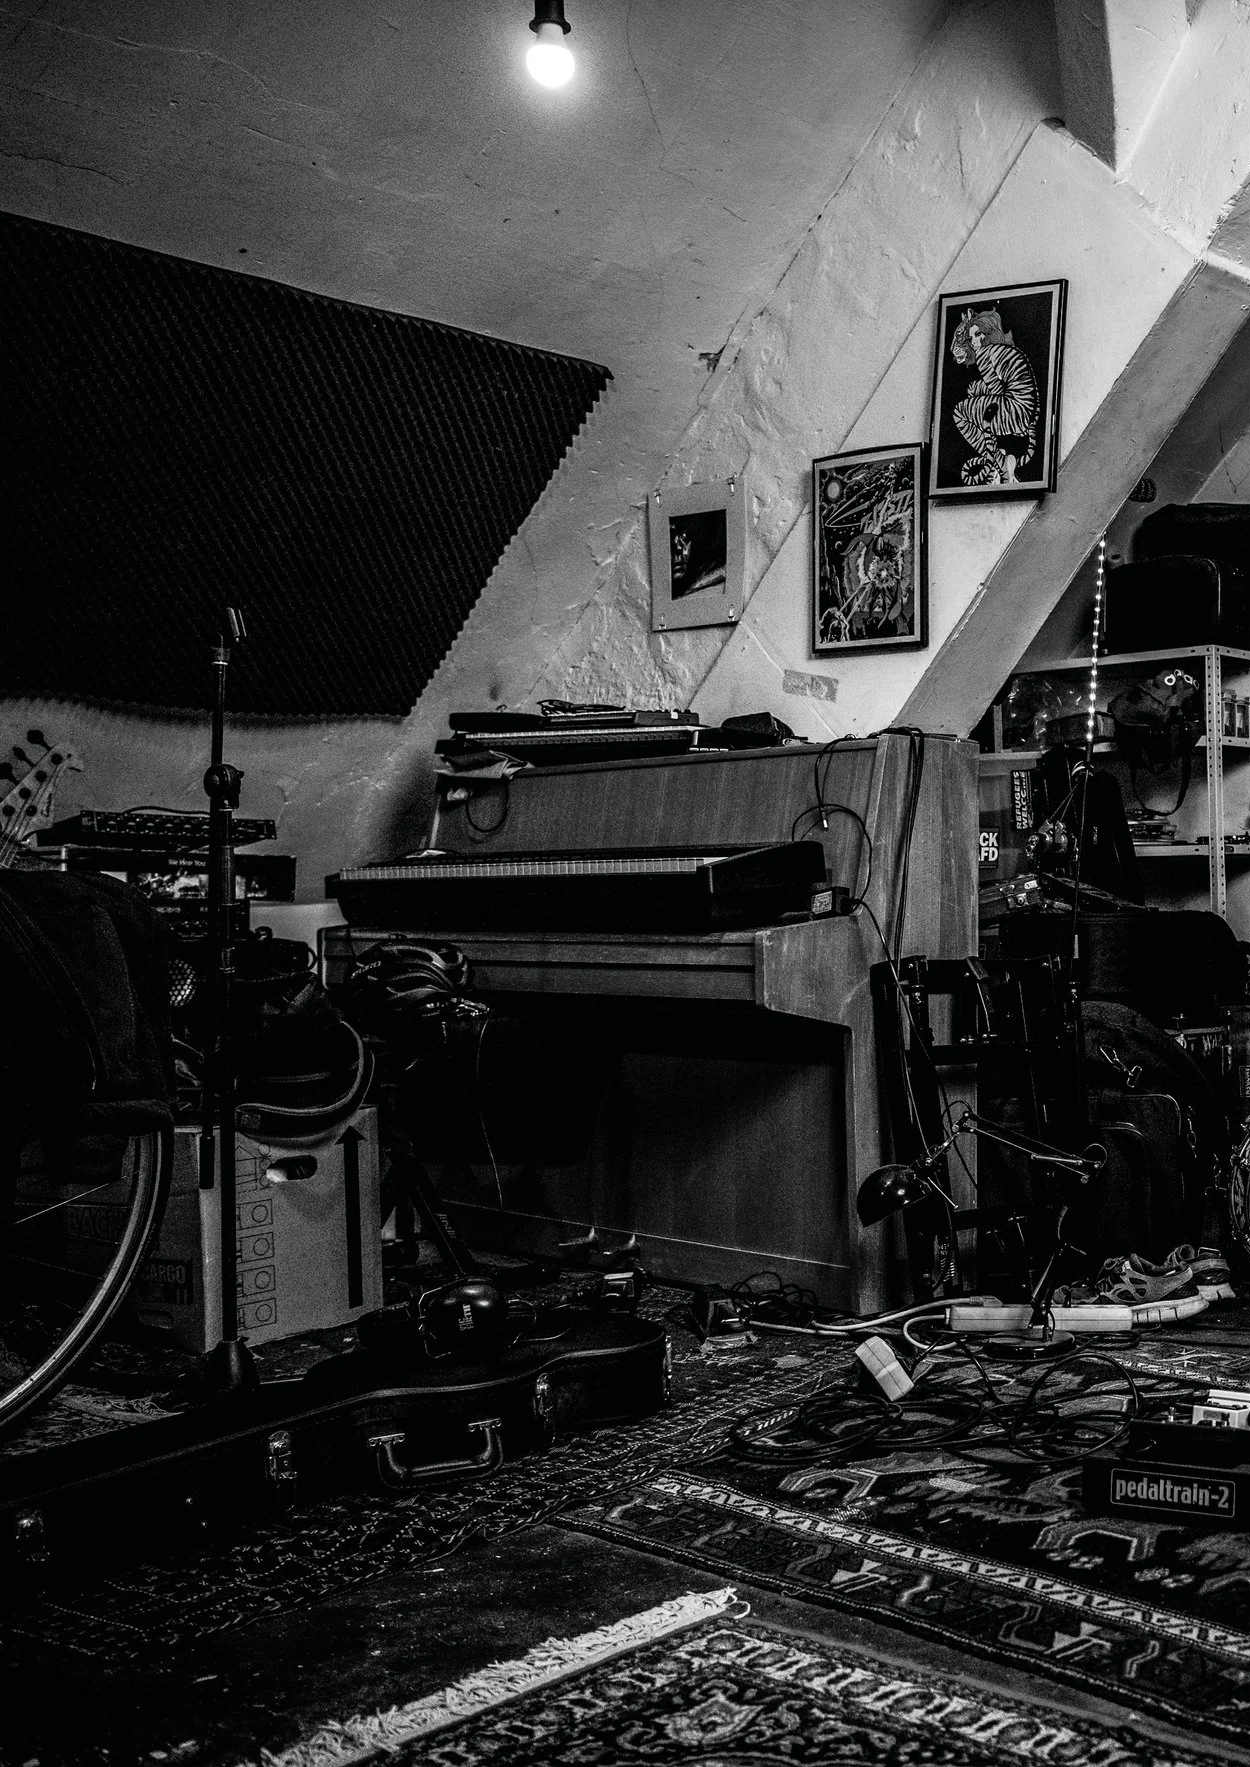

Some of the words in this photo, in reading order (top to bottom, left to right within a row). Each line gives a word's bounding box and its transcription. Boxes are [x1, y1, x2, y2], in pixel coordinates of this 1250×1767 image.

[1013, 772, 1022, 829] REFUGEES
[979, 832, 998, 847] CK
[979, 847, 998, 862] FD
[1115, 1476, 1230, 1509] pedaltrain-2
